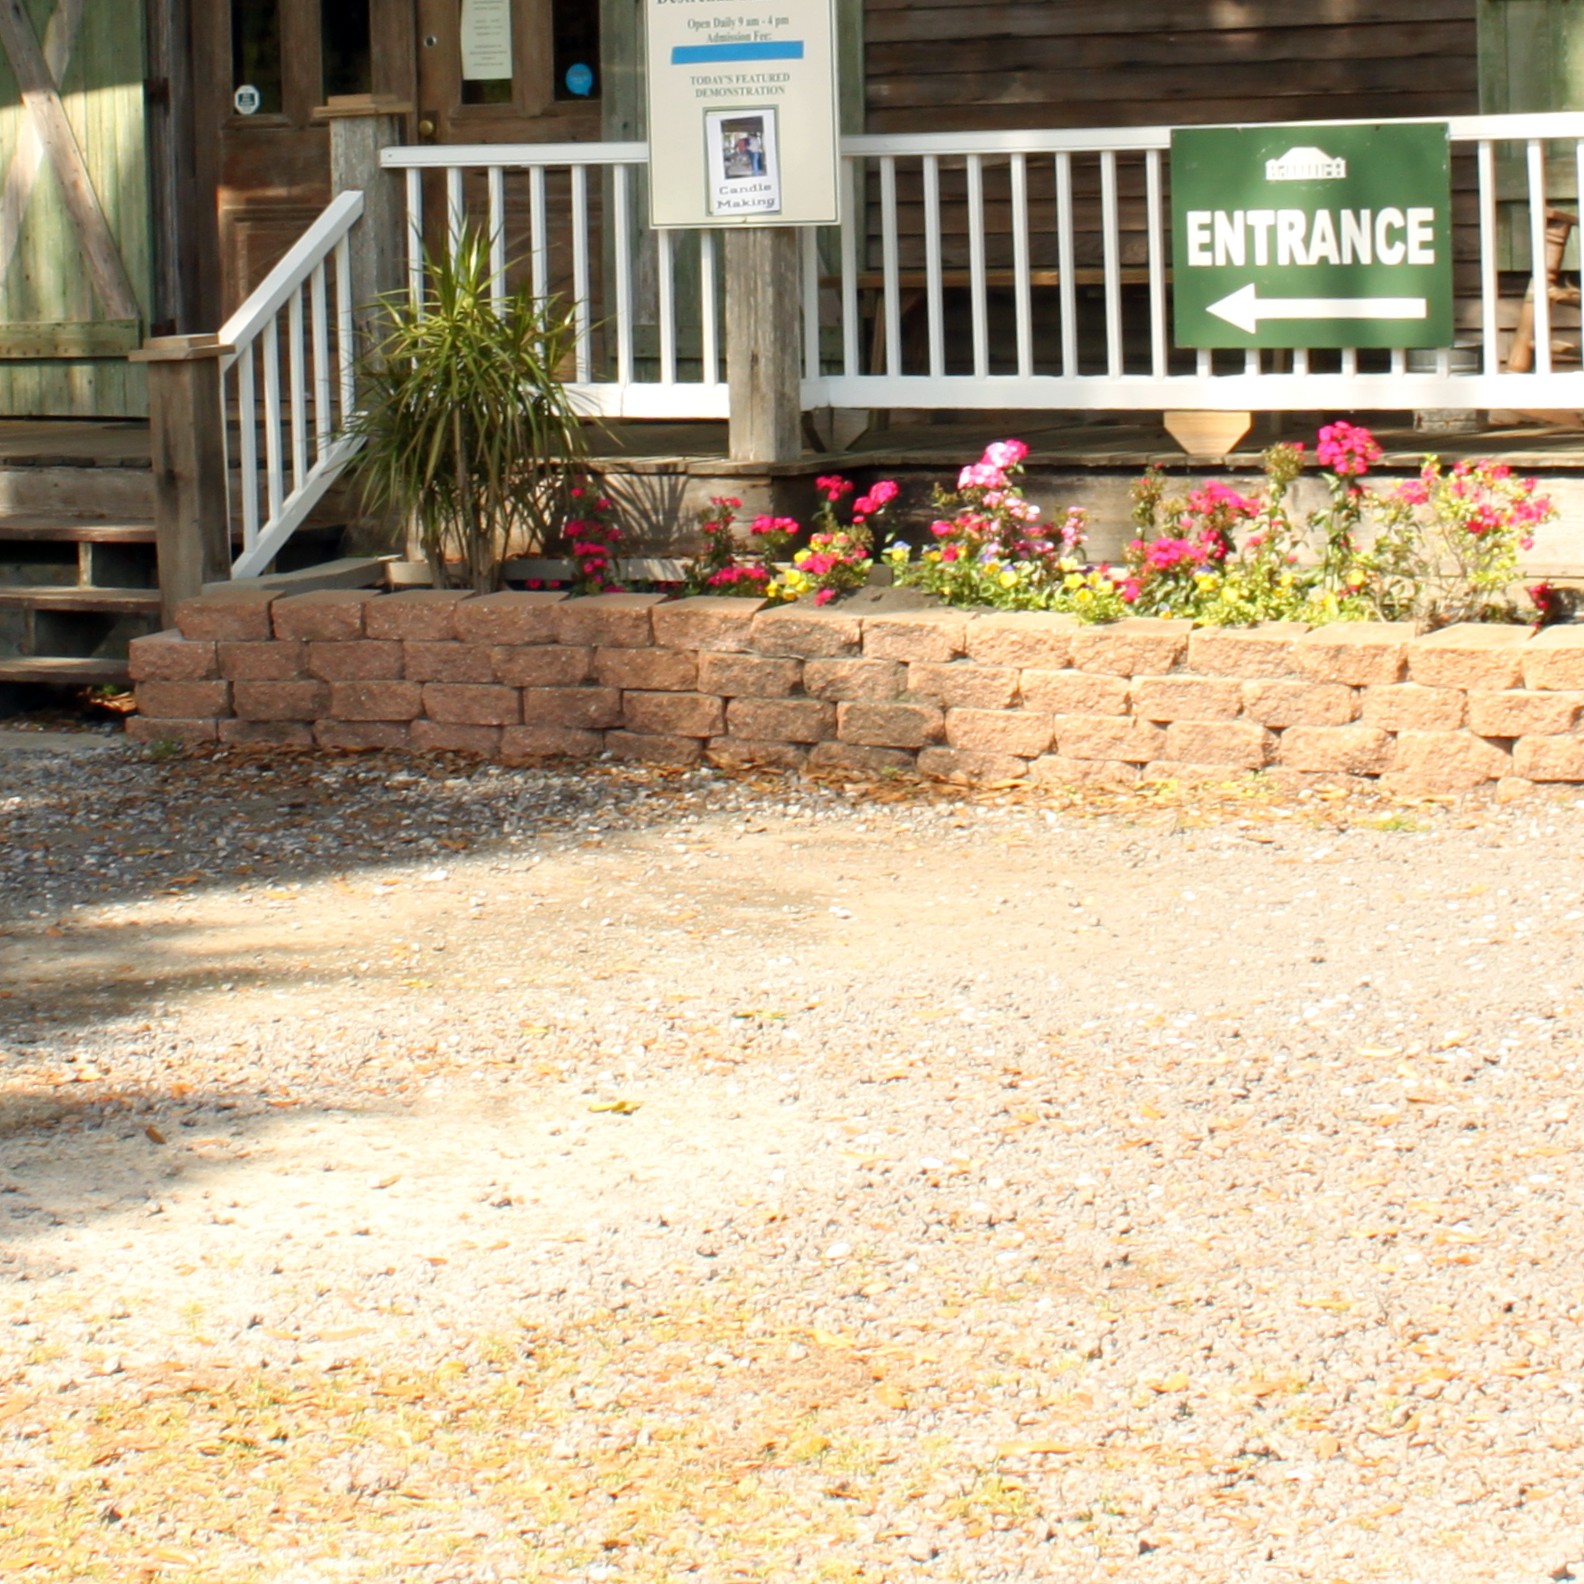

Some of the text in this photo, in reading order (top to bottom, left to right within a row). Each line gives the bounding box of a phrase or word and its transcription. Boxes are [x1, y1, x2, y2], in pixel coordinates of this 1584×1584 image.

[687, 18, 711, 32] Open
[713, 16, 735, 30] Daily
[738, 16, 744, 26] 9
[746, 18, 760, 26] am
[767, 16, 773, 25] 4
[775, 17, 789, 28] pm
[707, 31, 752, 43] Admission
[690, 72, 790, 86] TODAY'S FEATURED
[694, 85, 786, 98] DEMONSTRATION
[718, 183, 772, 195] Candle
[717, 198, 775, 209] Making
[1185, 207, 1436, 267] ENTRANCE
